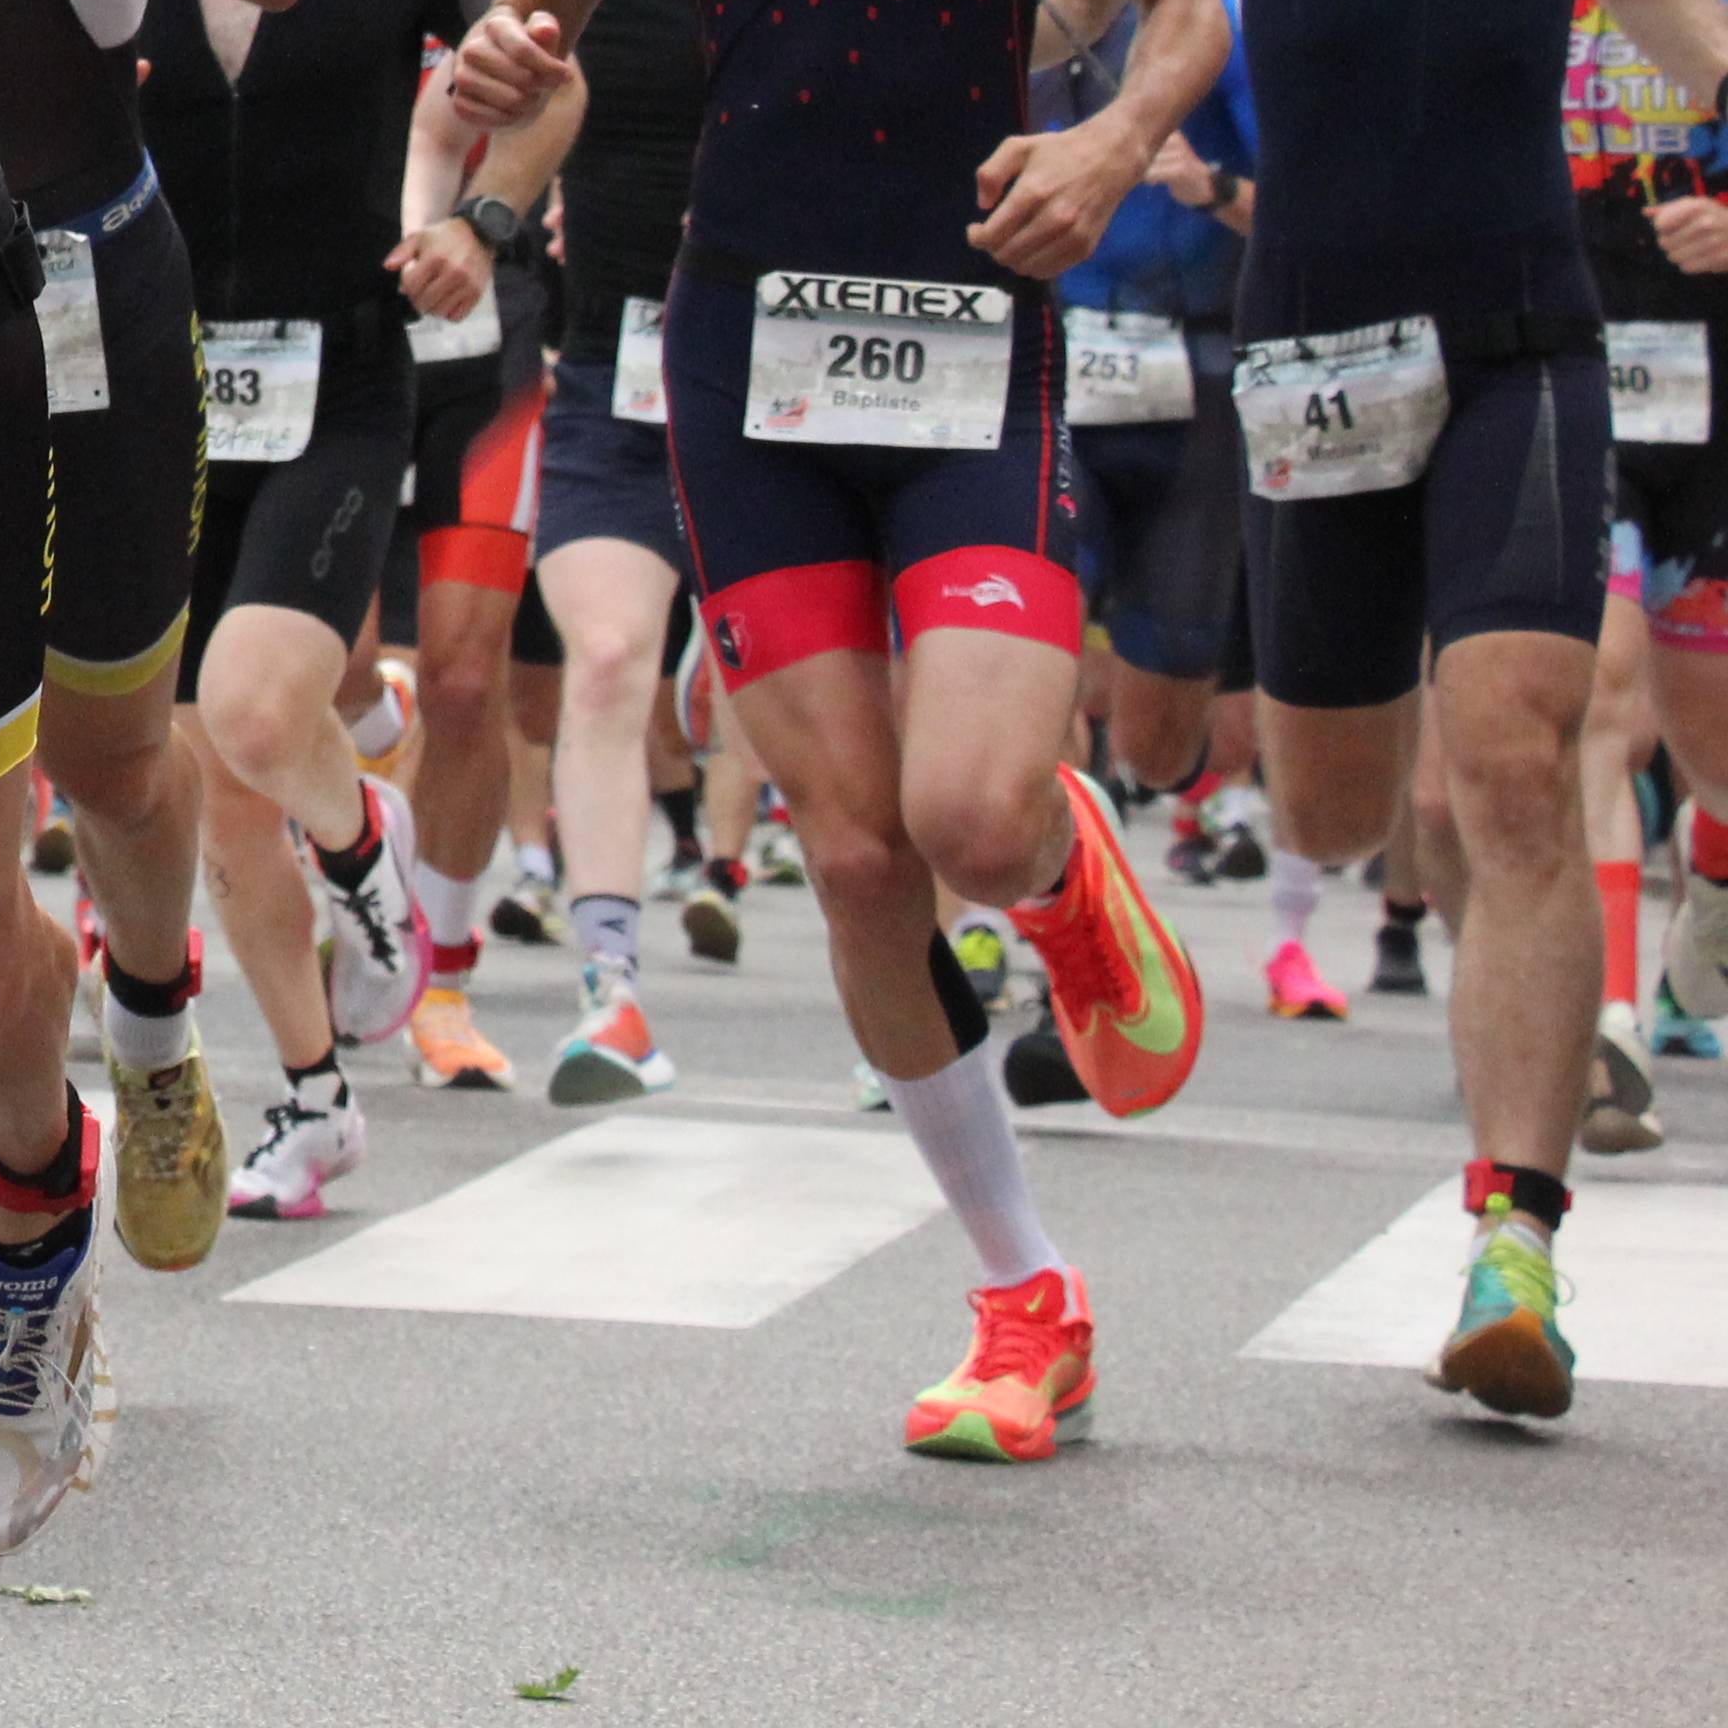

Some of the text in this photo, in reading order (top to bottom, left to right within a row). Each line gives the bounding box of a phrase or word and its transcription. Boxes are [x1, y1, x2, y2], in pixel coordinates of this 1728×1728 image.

[827, 334, 926, 384] 260
[832, 389, 922, 413] Baptiste
[1304, 389, 1355, 433] 41
